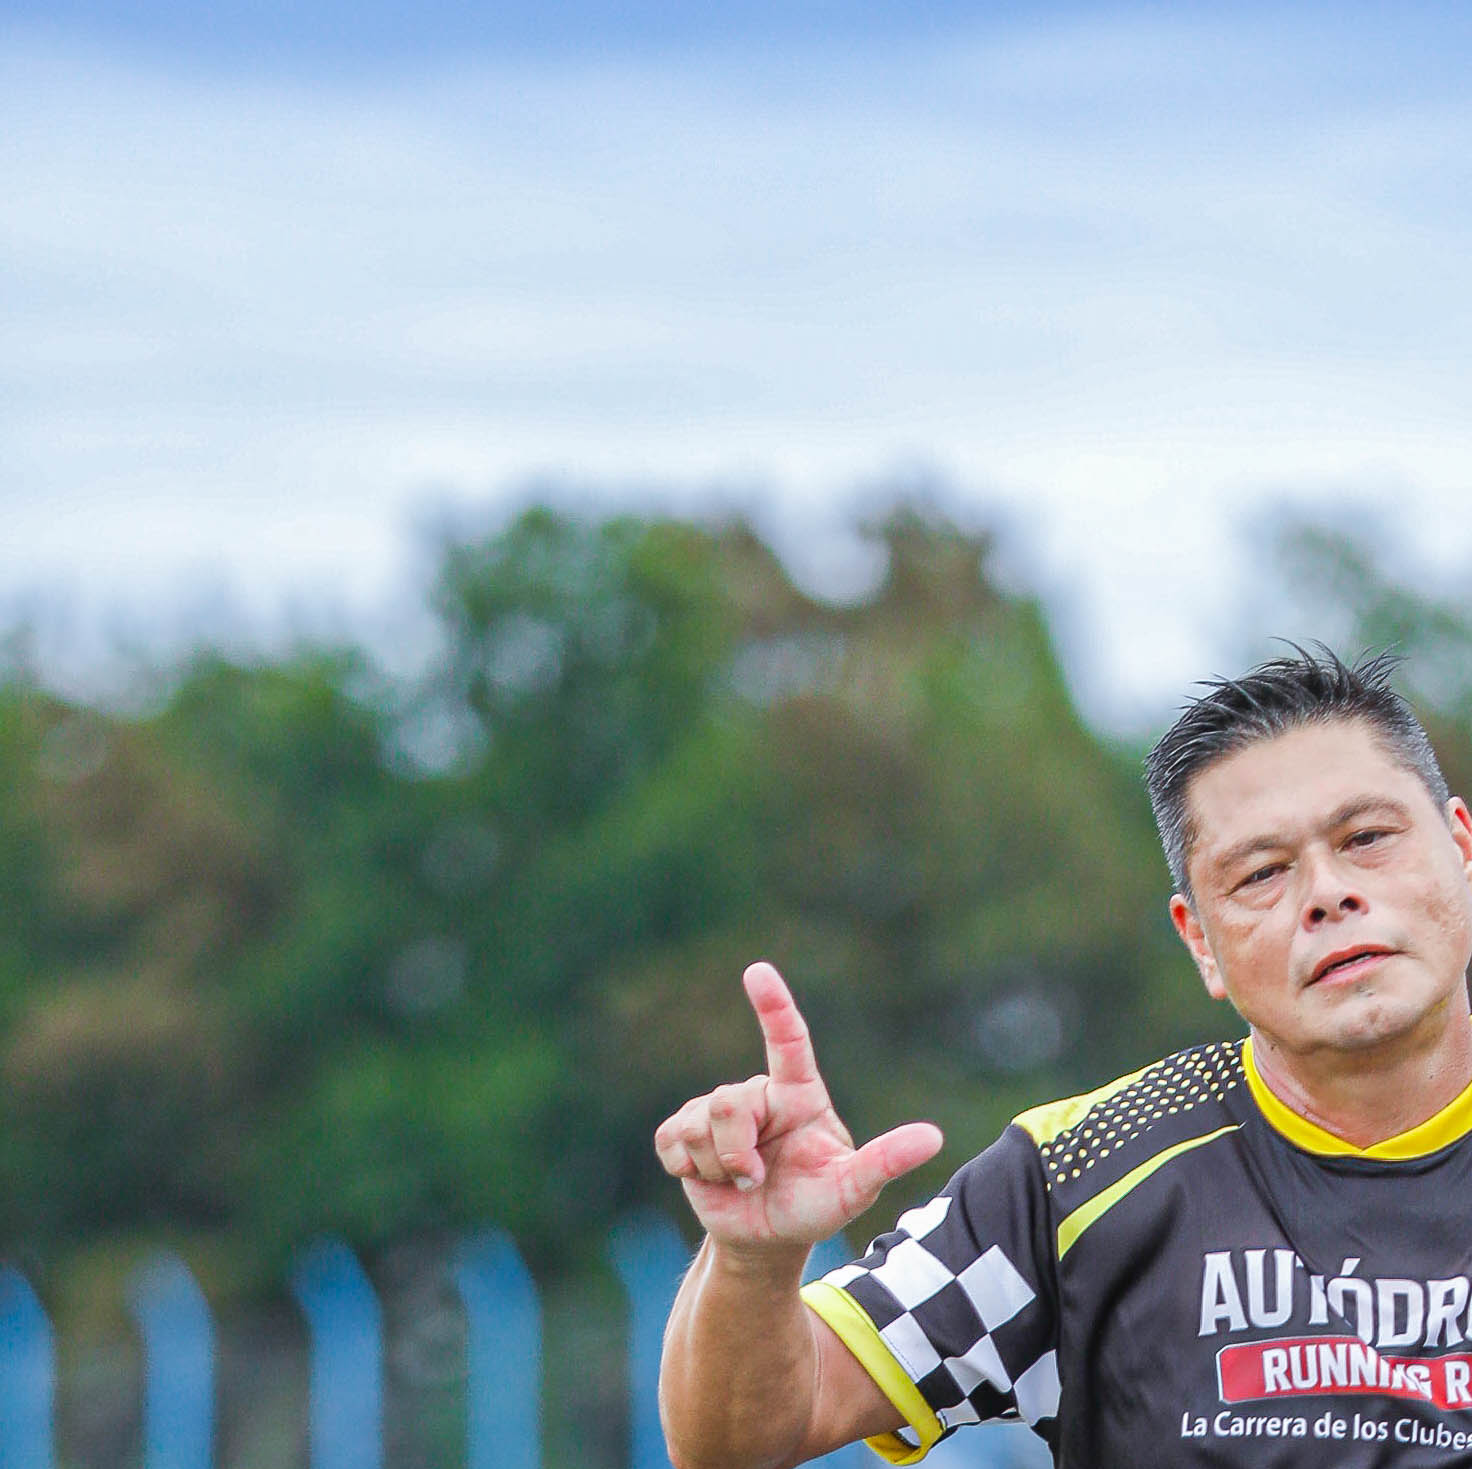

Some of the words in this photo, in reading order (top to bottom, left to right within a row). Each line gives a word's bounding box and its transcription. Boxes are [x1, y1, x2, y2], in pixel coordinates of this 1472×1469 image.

[1262, 1342, 1433, 1400] RUNNING
[1181, 1411, 1208, 1438] La
[1213, 1410, 1307, 1437] Carrera
[1314, 1412, 1347, 1439] de
[1352, 1413, 1388, 1441] los
